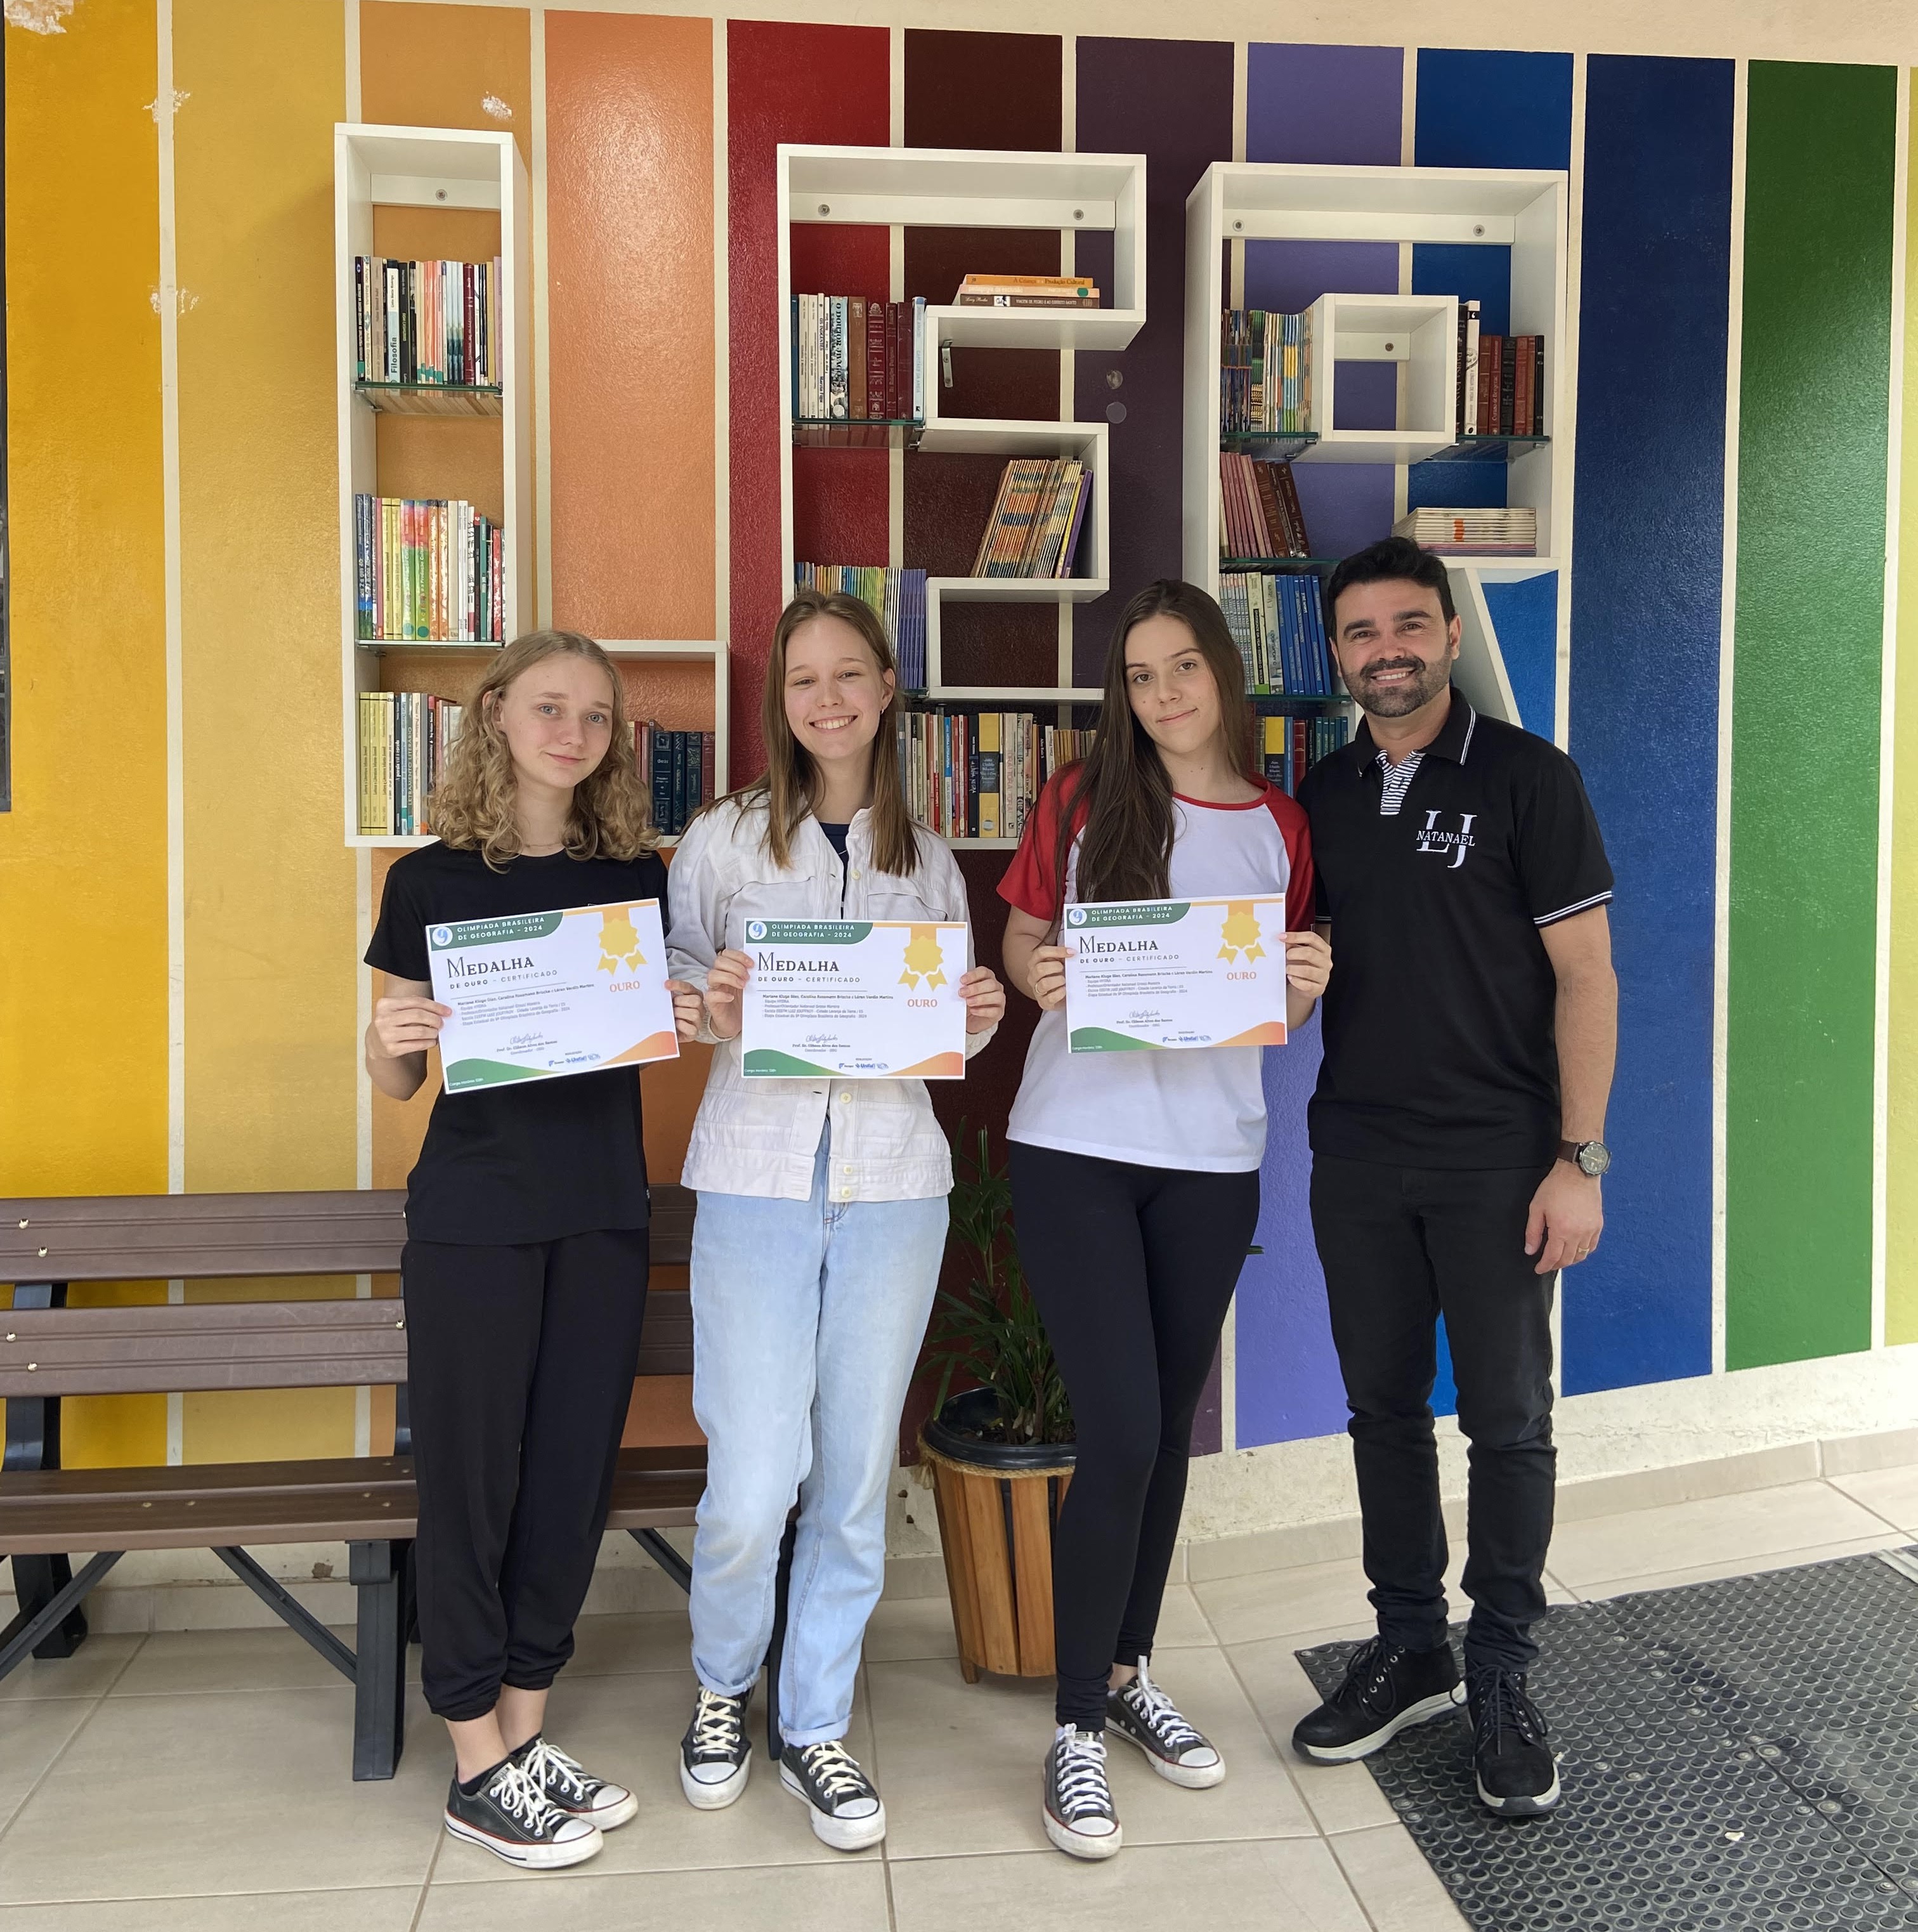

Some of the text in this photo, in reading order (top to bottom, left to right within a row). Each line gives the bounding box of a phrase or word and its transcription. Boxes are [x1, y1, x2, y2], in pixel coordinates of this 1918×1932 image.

[1416, 830, 1475, 847] NATANAEL
[502, 917, 544, 927] BRASILEIRA
[471, 929, 514, 939] GEOGRAFIA
[1080, 936, 1159, 954] MEDALHA
[447, 956, 535, 978] MEDALHA
[758, 952, 840, 972] MEDALHA
[501, 970, 558, 982] CERTIFICADO
[1226, 971, 1257, 981] OURO
[610, 981, 640, 993] OURO
[907, 998, 937, 1008] OURO
